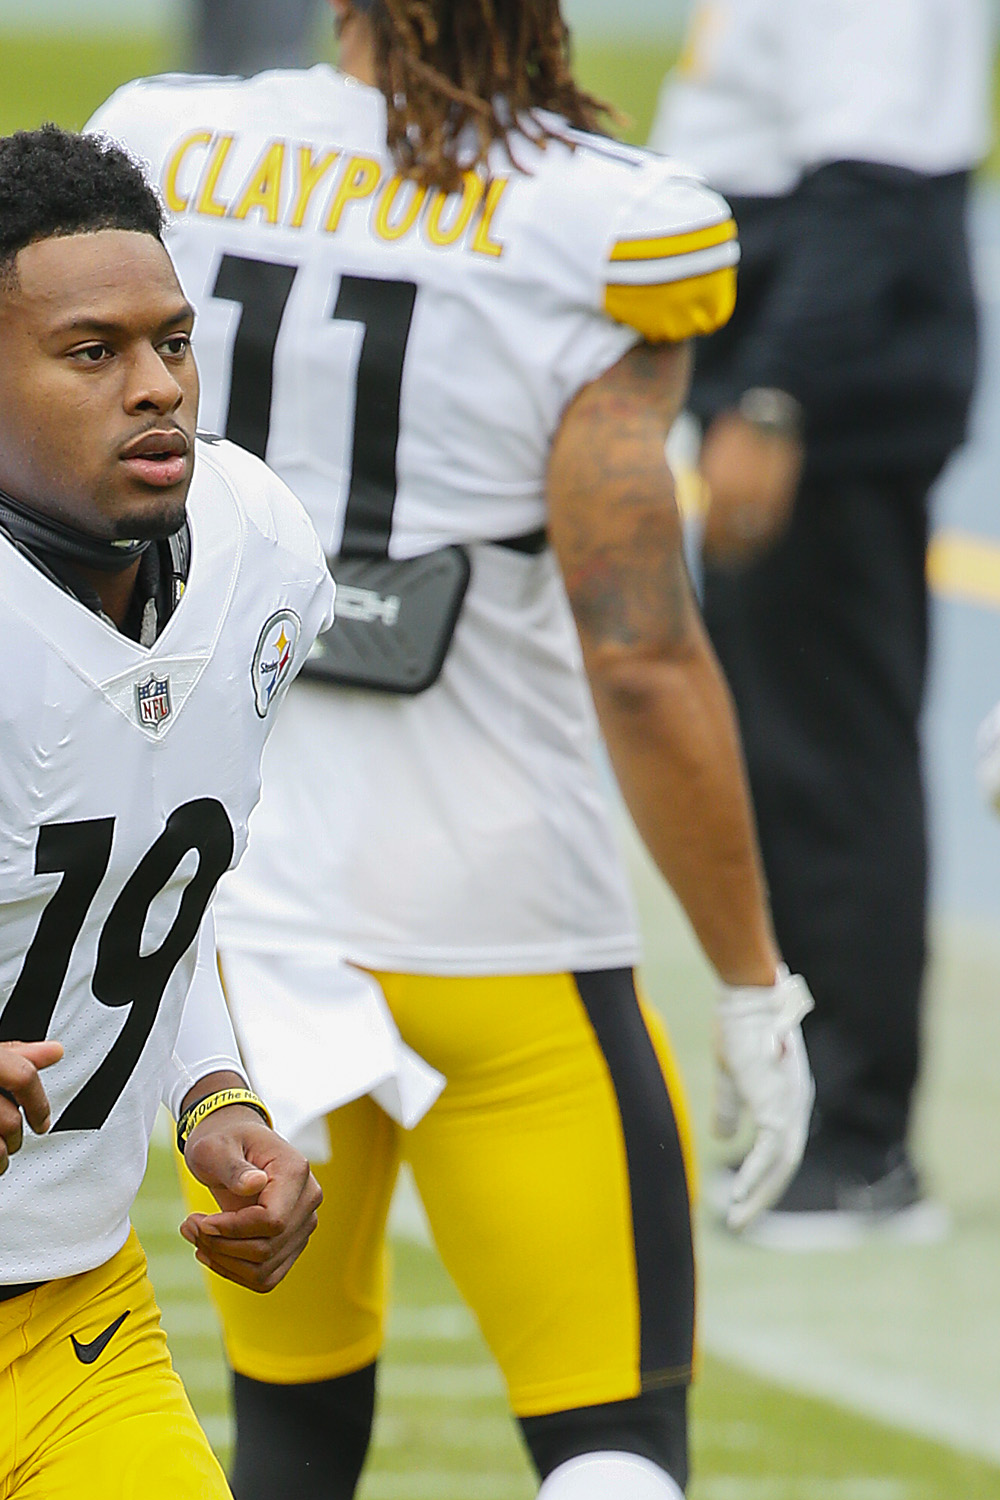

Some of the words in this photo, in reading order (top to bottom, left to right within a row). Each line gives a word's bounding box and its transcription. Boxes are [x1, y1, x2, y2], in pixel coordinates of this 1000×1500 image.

[165, 131, 509, 257] CLAYPOOL
[212, 254, 417, 558] 11
[143, 697, 168, 720] NFL
[198, 1094, 219, 1117] Out
[220, 1090, 241, 1102] The
